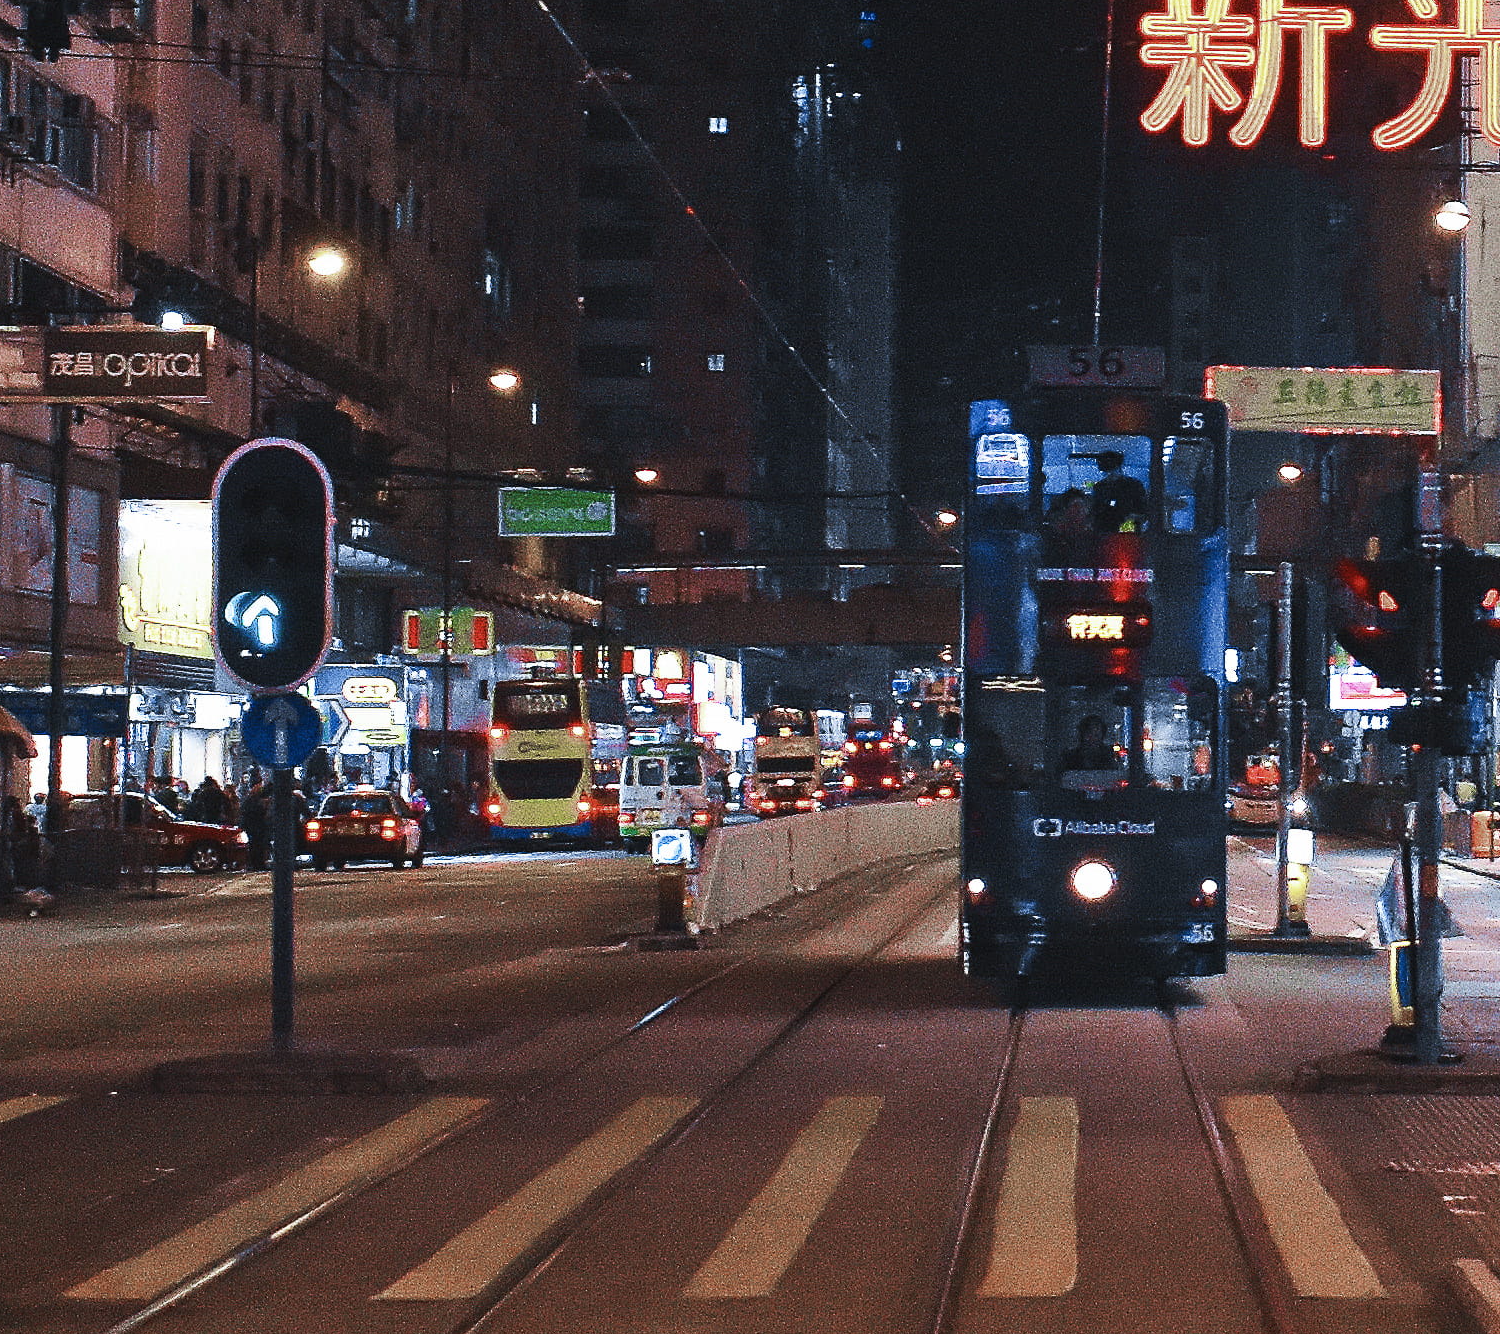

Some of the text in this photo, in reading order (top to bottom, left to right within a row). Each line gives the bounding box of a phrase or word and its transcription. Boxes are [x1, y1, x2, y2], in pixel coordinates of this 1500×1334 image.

[50, 352, 94, 376] 茂昌
[1067, 347, 1126, 378] 56
[1181, 412, 1205, 430] 56
